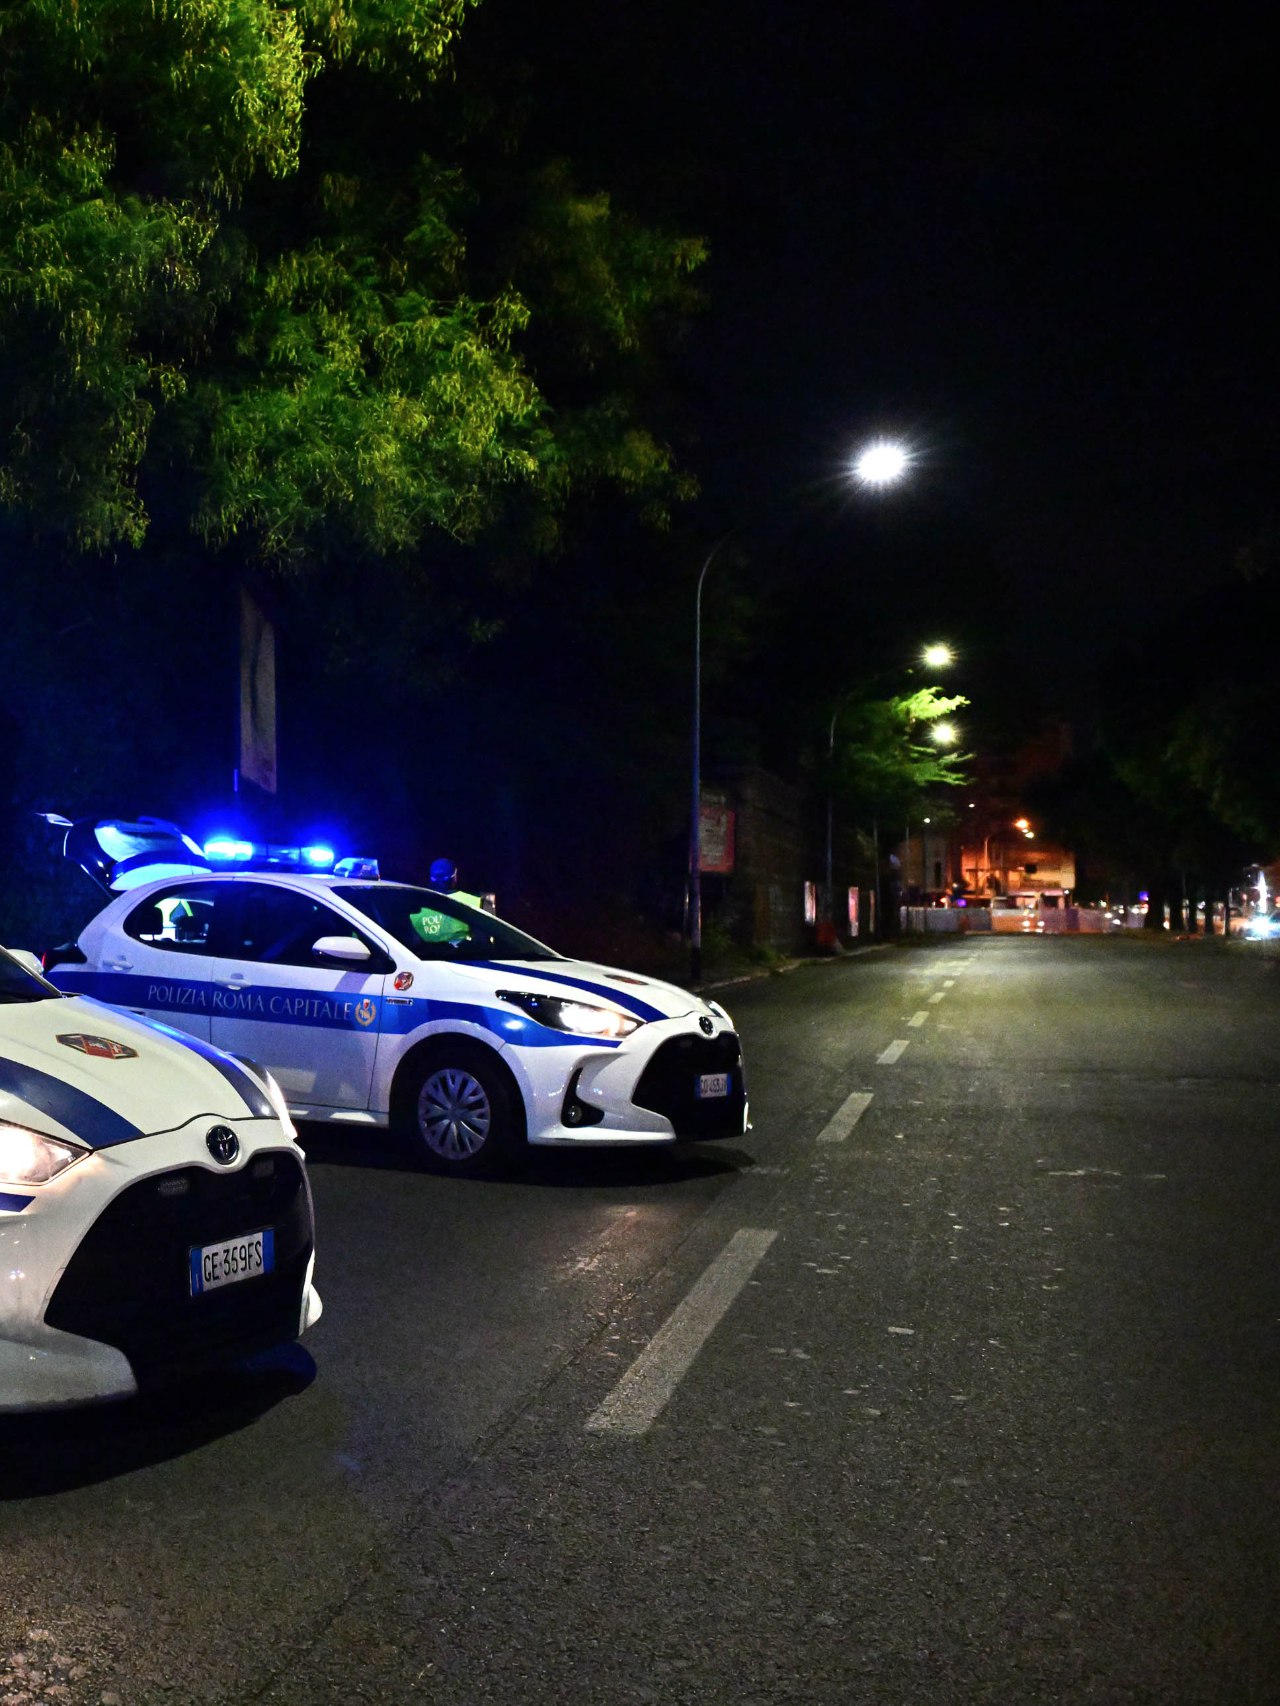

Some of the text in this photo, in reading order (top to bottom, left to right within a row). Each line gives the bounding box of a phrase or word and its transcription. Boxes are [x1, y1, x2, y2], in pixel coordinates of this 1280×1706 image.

[148, 984, 352, 1020] POLIZIA ROMA CAPITALE
